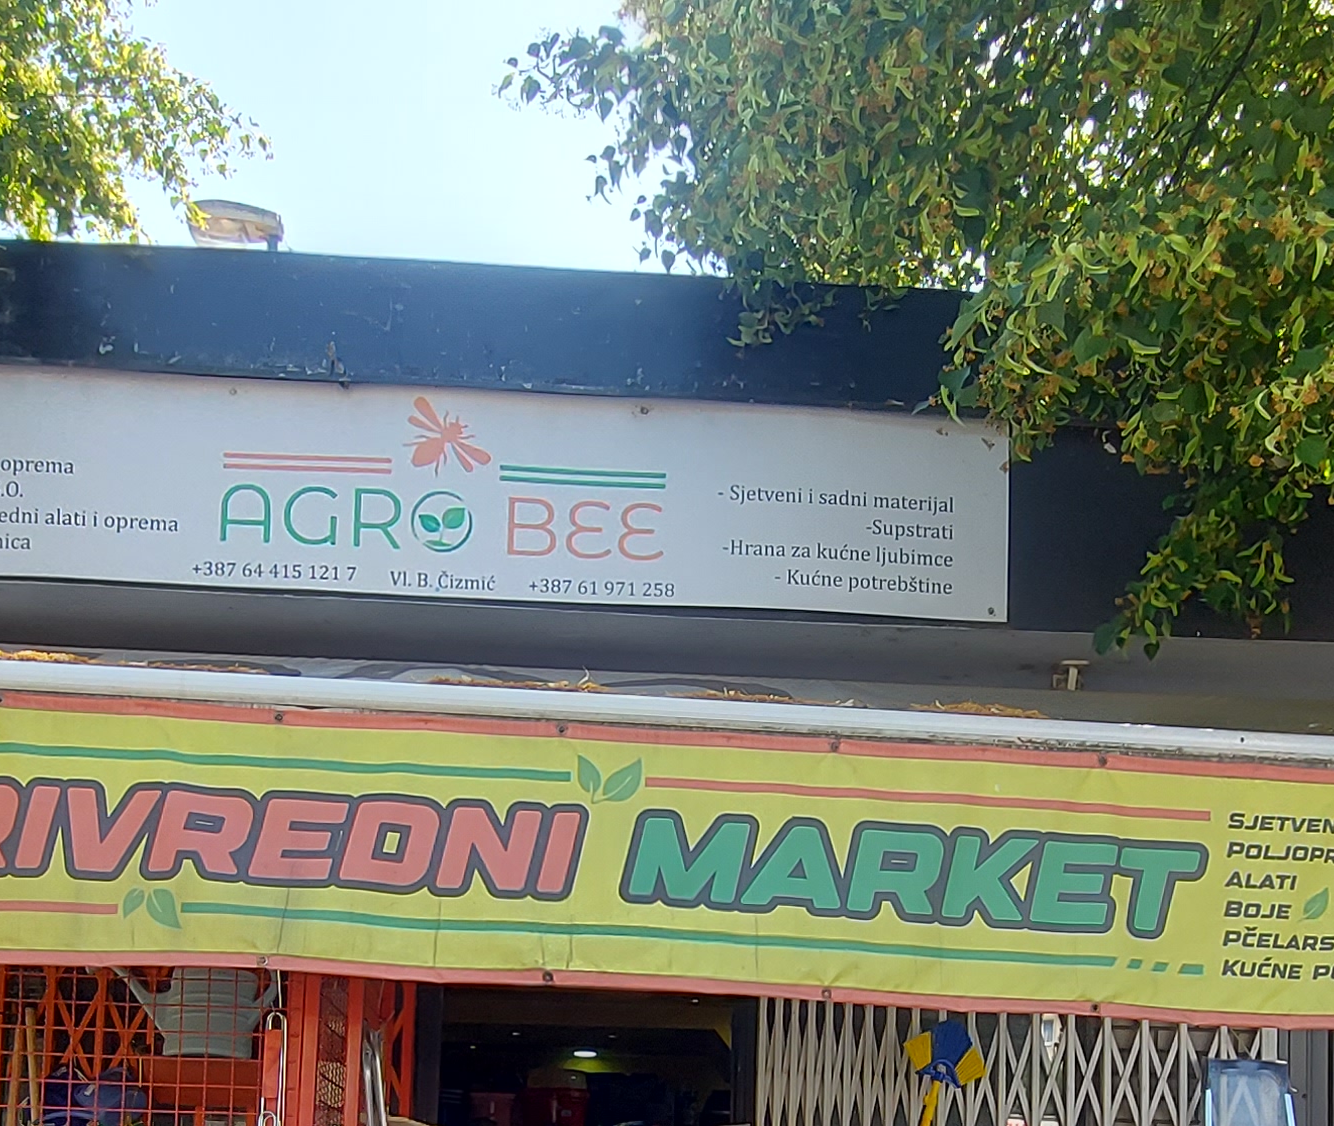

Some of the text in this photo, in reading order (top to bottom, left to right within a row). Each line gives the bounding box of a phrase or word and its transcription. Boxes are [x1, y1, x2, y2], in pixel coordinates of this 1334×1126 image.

[0, 458, 75, 477] oprema
[729, 484, 803, 505] Sjetveni
[808, 487, 815, 504] i
[819, 487, 867, 507] sadni
[873, 492, 955, 518] materijal
[44, 508, 87, 527] alati
[93, 510, 99, 527] i
[104, 514, 179, 535] oprema
[791, 546, 812, 559] za
[817, 542, 871, 563] kućne
[875, 545, 954, 569] ljubimce
[192, 561, 357, 581] +387 64 415 121 7
[417, 573, 432, 588] B.
[438, 570, 496, 591] Čizmić
[787, 568, 843, 589] Kućne
[848, 572, 953, 597] potrebštine
[529, 578, 675, 597] +387 61 971 258
[619, 808, 1209, 939] MARKET
[1224, 871, 1298, 891] ALATI
[1223, 900, 1292, 920] BOJE
[1221, 955, 1302, 981] KUĆNE
